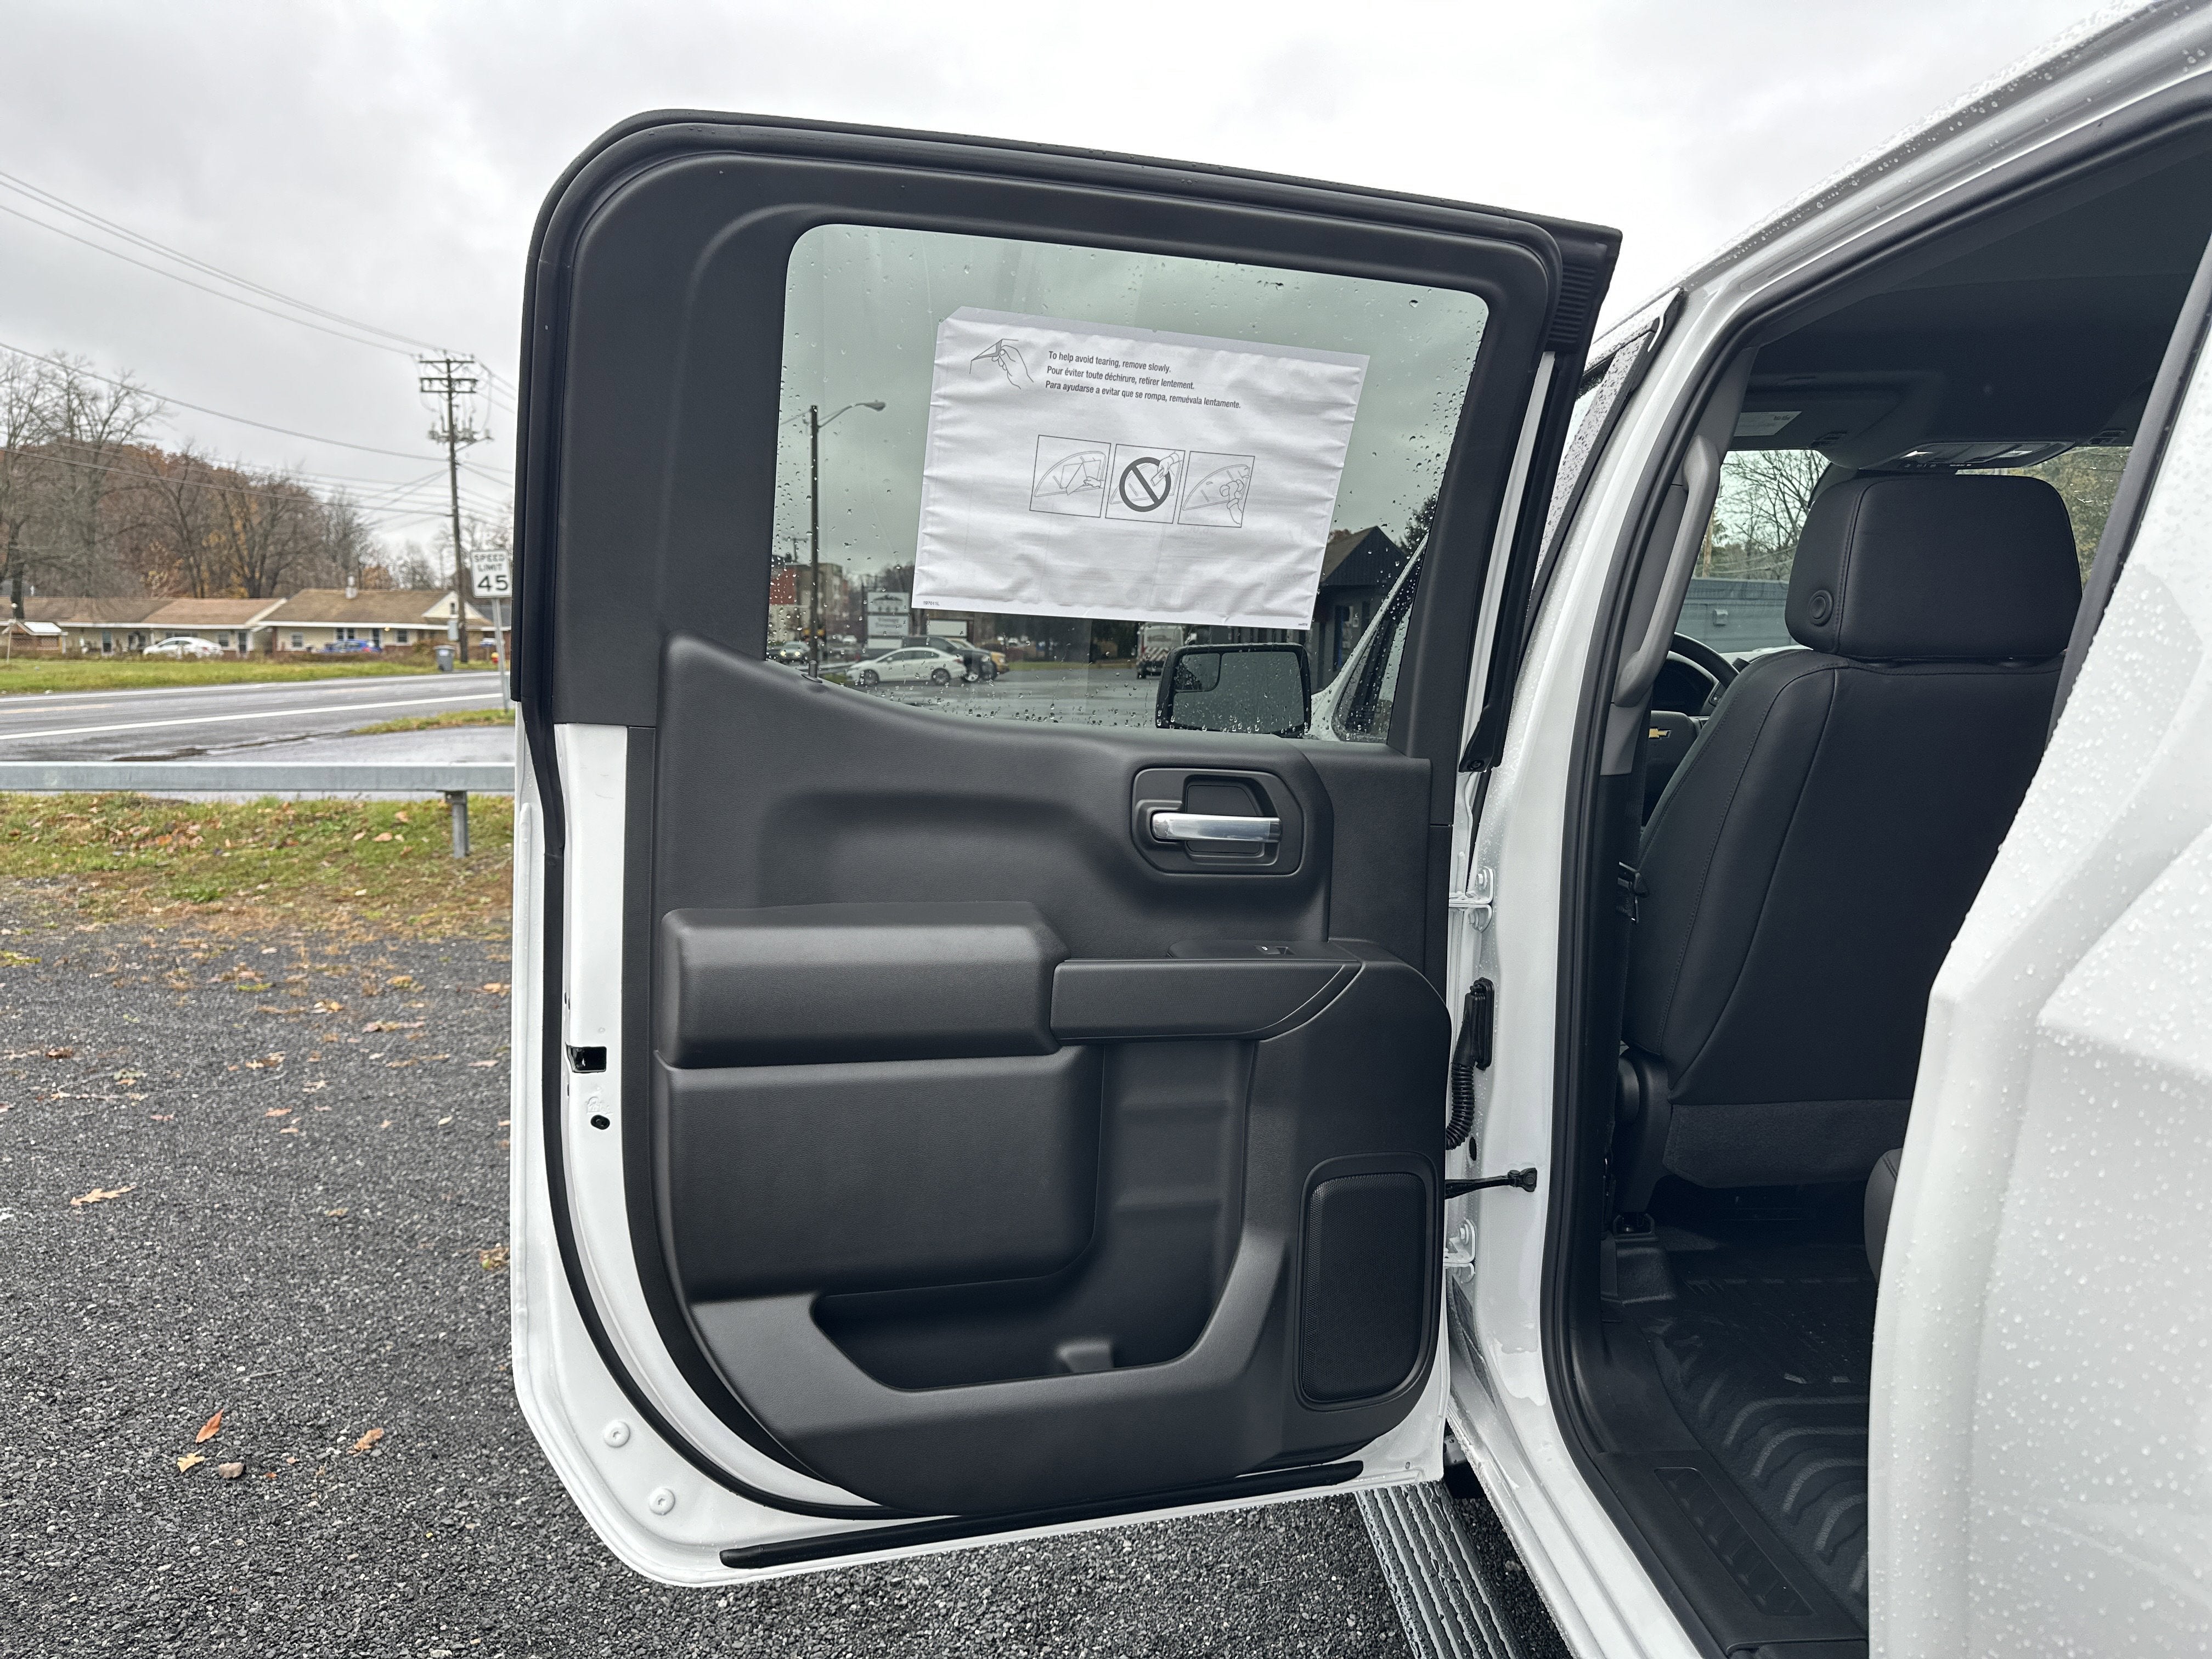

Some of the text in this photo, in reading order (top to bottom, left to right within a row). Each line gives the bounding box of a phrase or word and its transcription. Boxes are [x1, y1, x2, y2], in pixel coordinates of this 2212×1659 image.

[1049, 351, 1171, 374] To help avoid tearing, remove slowly.
[1047, 366, 1195, 390] Pour éviter toute déchirure, retirer lentement.
[1045, 380, 1061, 390] Para
[1063, 384, 1094, 393] ayudarse
[1102, 387, 1120, 396] evitar
[1122, 390, 1133, 398] que
[1144, 393, 1167, 402] rompa,
[1169, 395, 1202, 405] remuévala
[1204, 397, 1241, 409] lentamente.
[474, 554, 505, 562] SPEED
[477, 575, 508, 592] 45
